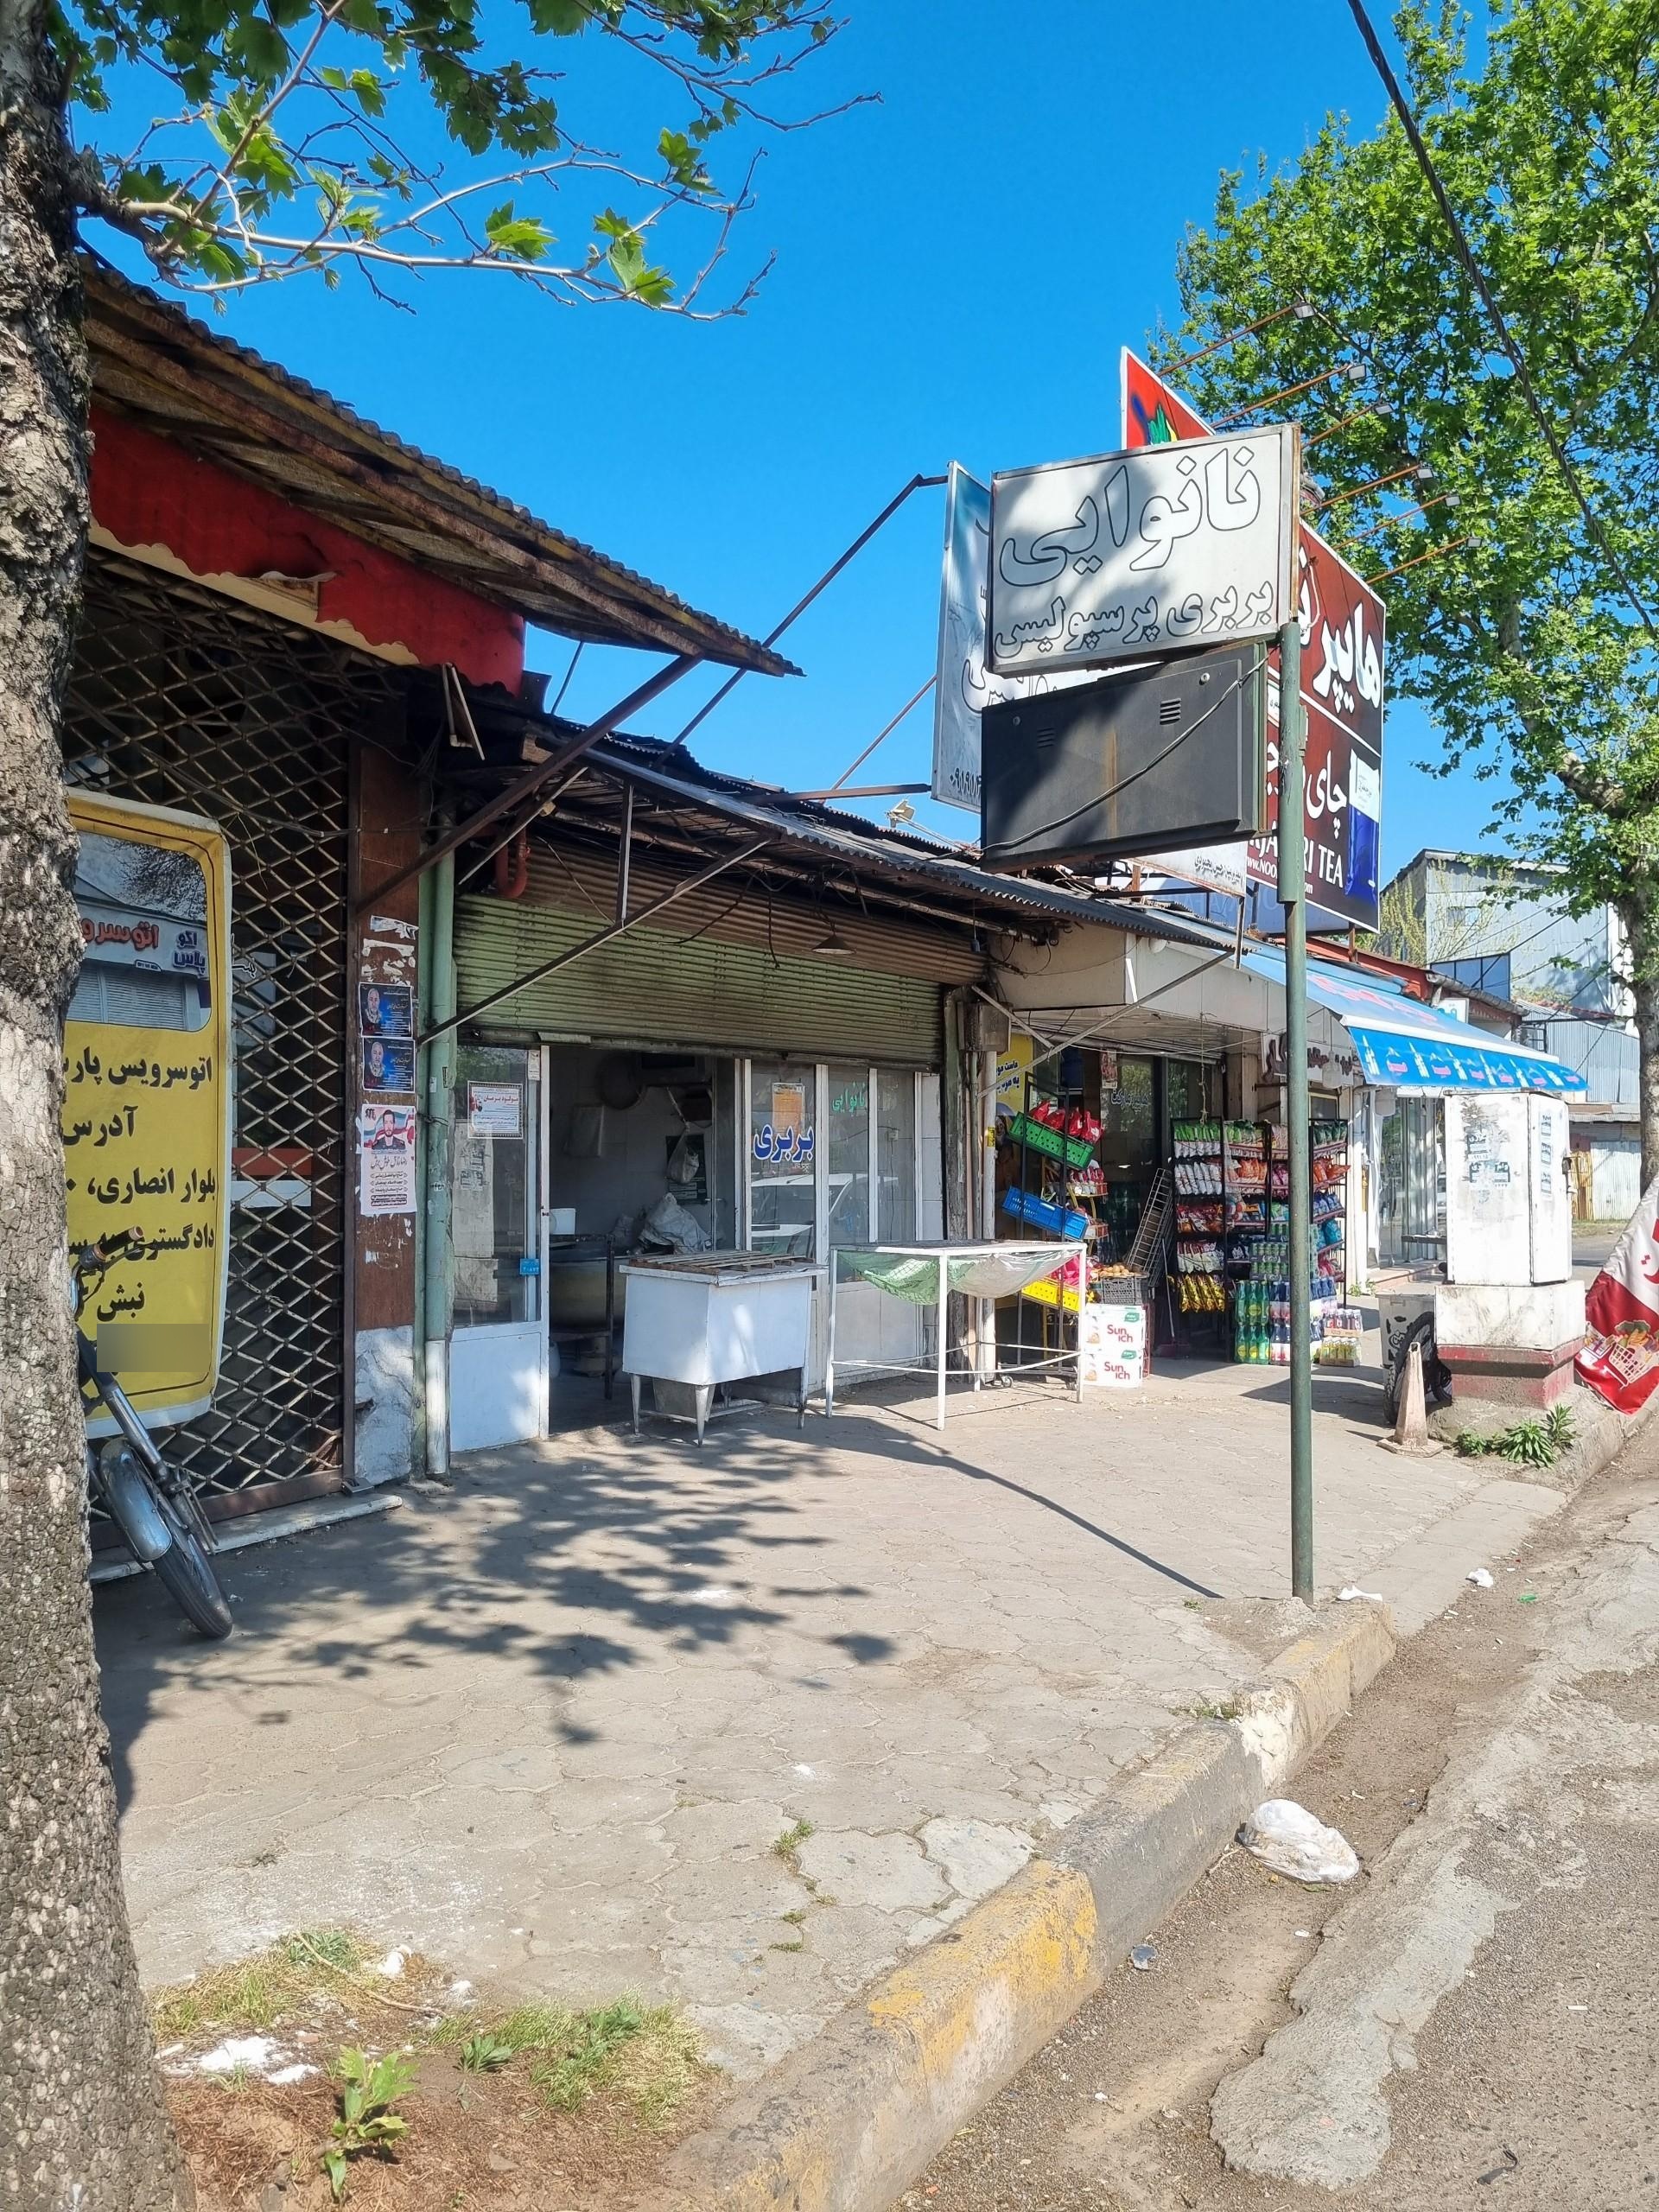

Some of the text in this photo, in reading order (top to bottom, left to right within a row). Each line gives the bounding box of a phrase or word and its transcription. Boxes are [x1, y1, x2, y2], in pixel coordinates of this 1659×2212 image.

[1000, 446, 1261, 587] نانوایی
[995, 596, 1159, 658] پرسپولیس
[1166, 581, 1274, 637] بربری
[1313, 601, 1381, 714] هایپر
[1306, 750, 1347, 839] چای
[1319, 843, 1344, 888] TEA
[63, 1046, 213, 1090] اتوسرویس پار
[753, 1124, 815, 1162] بربری
[180, 1167, 215, 1204] بلوار
[97, 1282, 145, 1322] نبش
[1107, 1325, 1127, 1335] Sun
[1118, 1334, 1134, 1343] ich
[1104, 1362, 1124, 1372] Sun
[1116, 1370, 1130, 1380] ich
